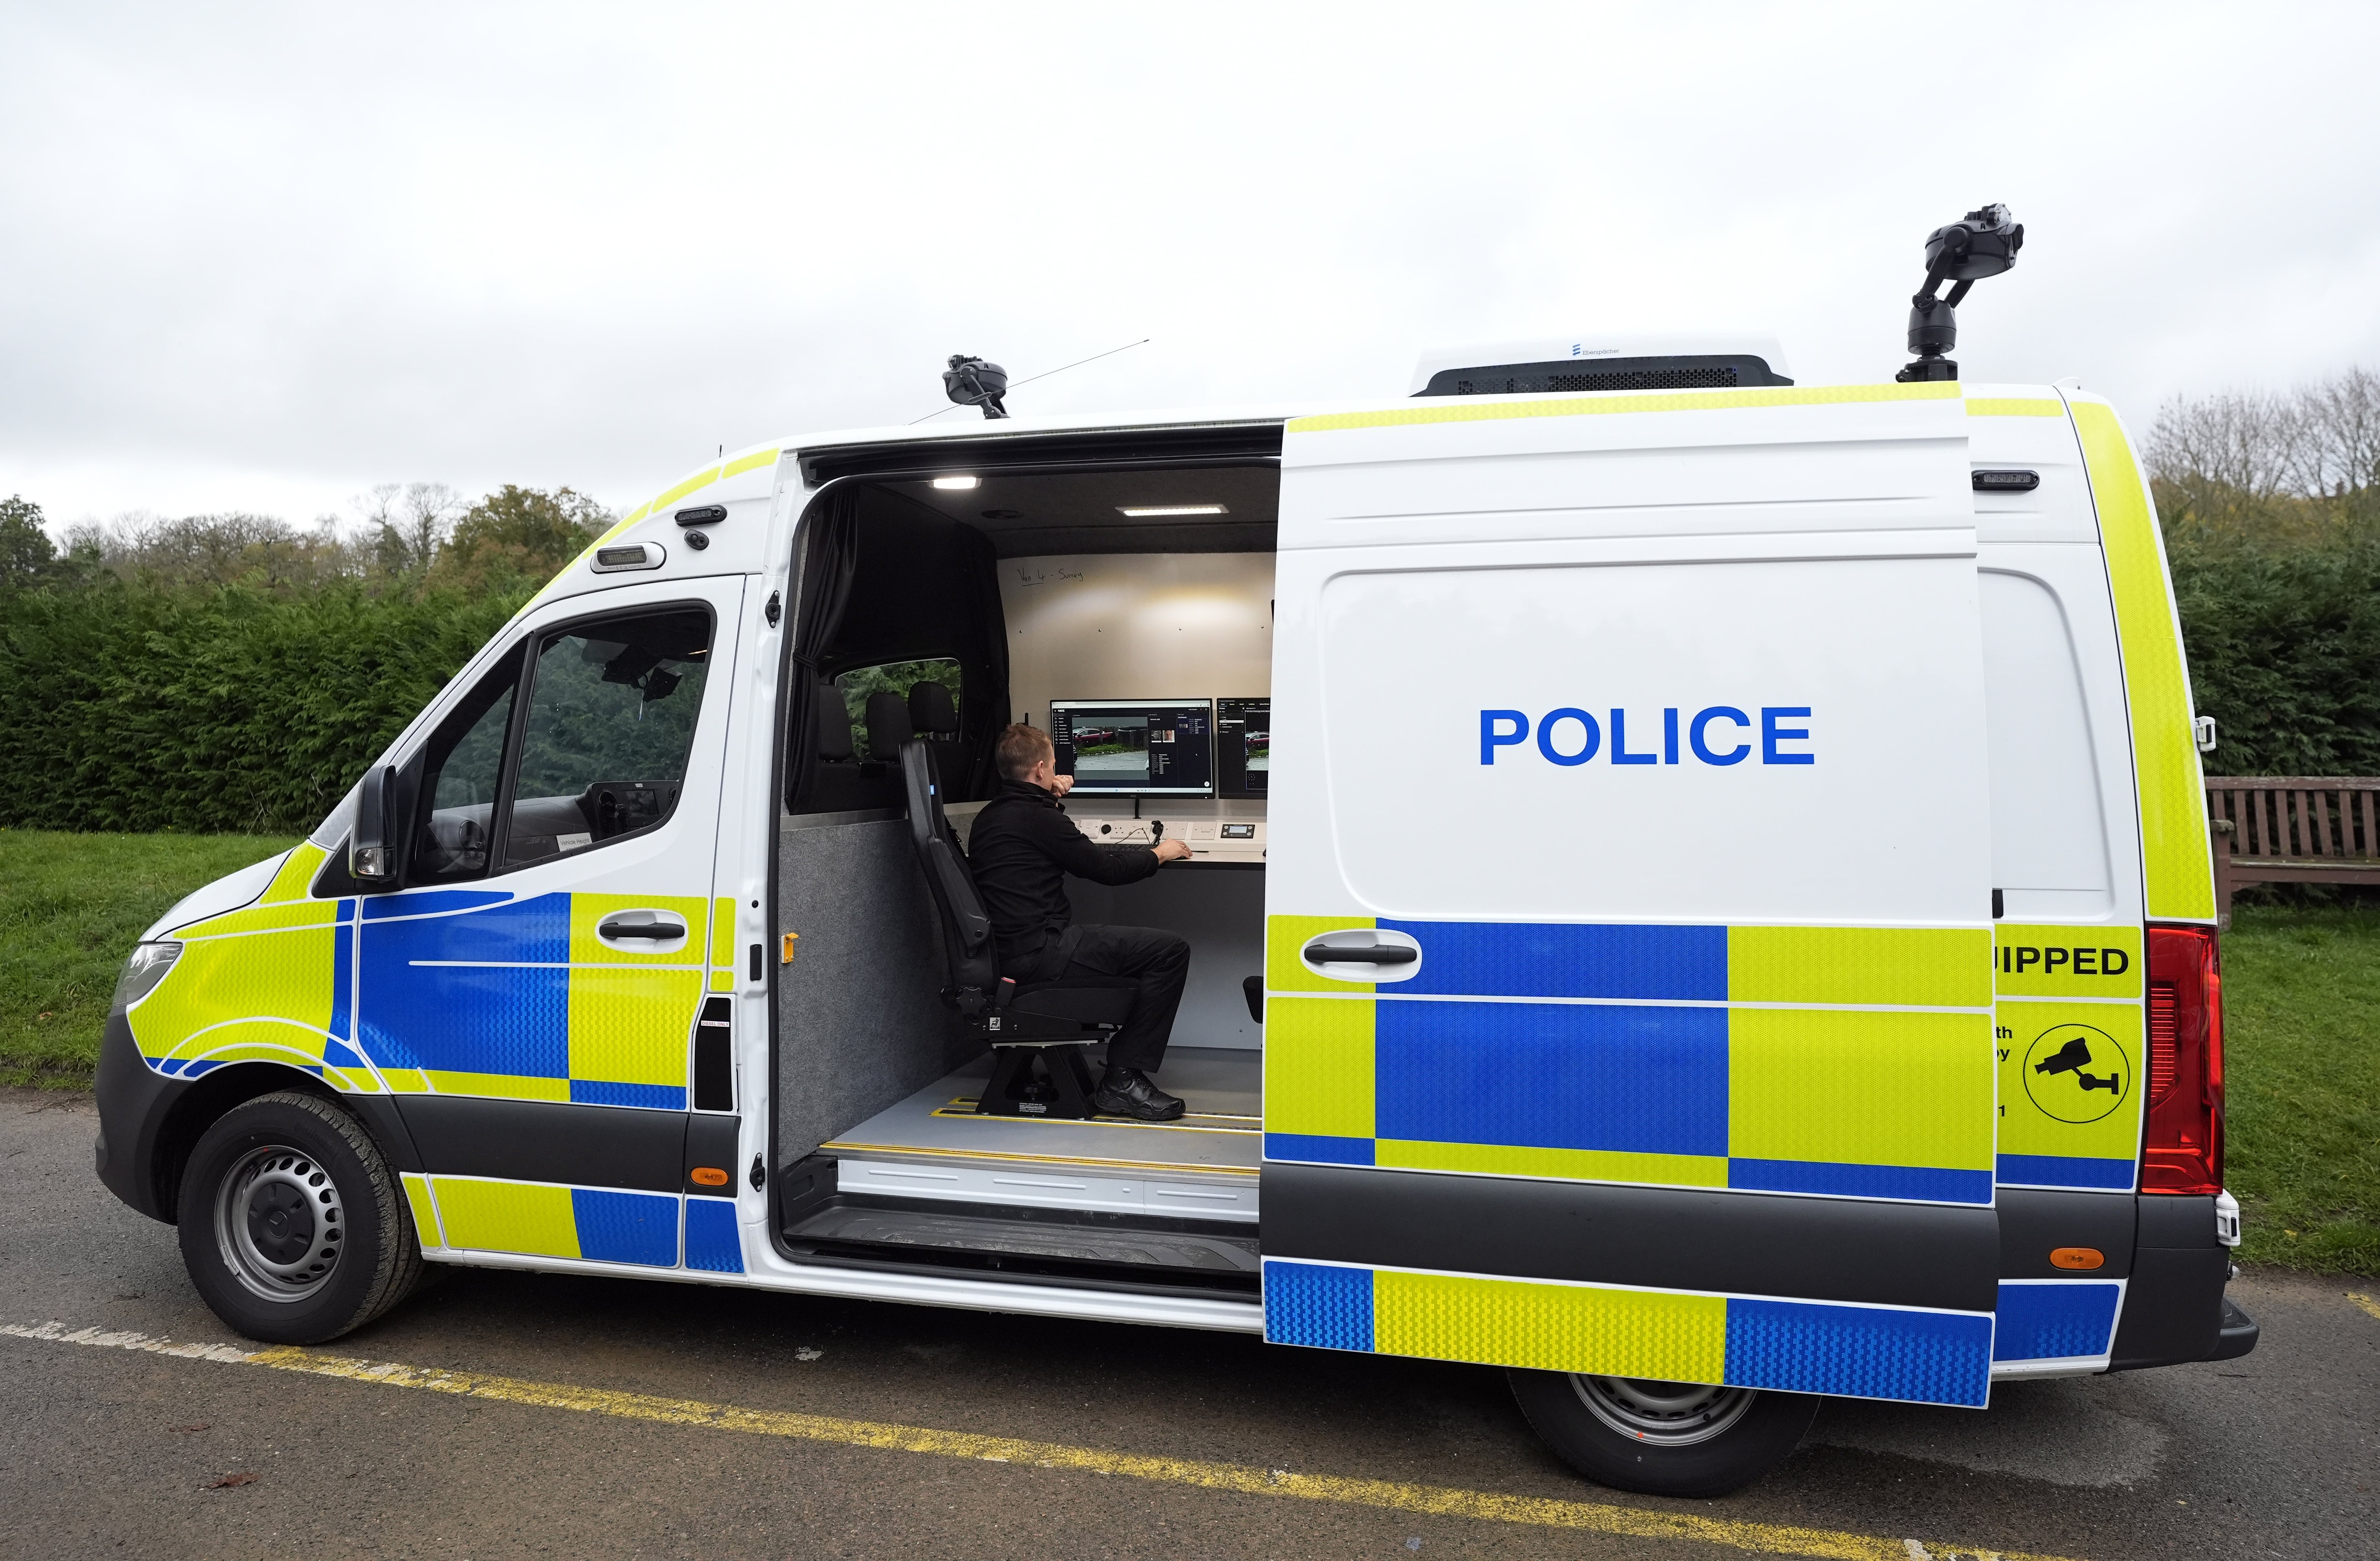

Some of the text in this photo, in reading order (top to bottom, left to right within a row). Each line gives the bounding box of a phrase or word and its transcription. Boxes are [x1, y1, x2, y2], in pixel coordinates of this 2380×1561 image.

[1017, 568, 1031, 581] Van
[1038, 569, 1045, 581] 4
[1059, 568, 1083, 582] Surrey
[1481, 706, 1814, 766] POLICE
[1995, 946, 2128, 975] IPPED
[1997, 1049, 2010, 1062] y
